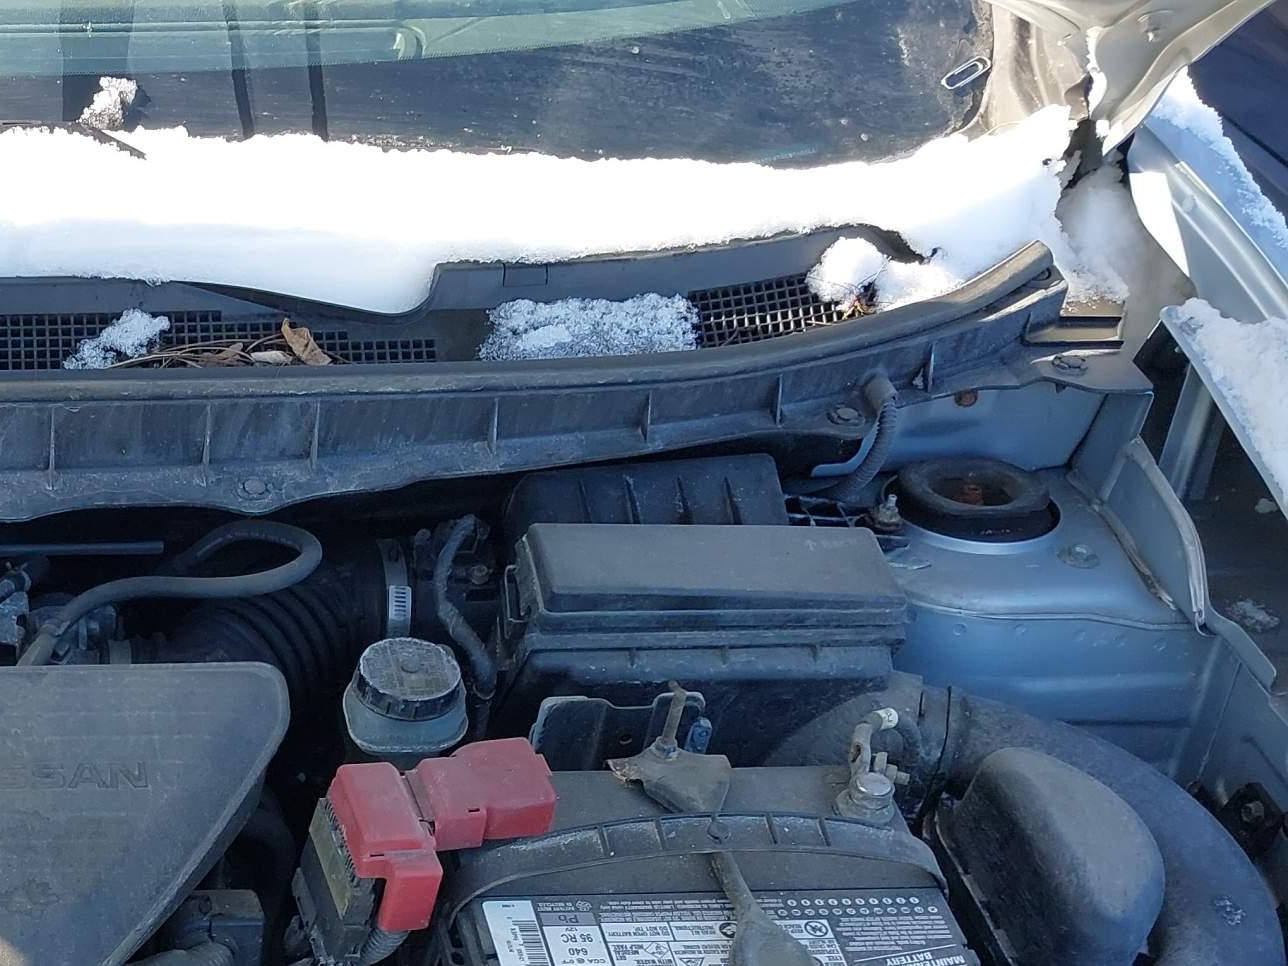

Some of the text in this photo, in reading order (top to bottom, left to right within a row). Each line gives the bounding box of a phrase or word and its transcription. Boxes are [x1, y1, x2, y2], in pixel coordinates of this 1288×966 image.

[558, 914, 579, 924] Pb
[560, 933, 593, 943] 95 RC
[568, 947, 588, 956] 640
[884, 951, 933, 966] BATTERY
